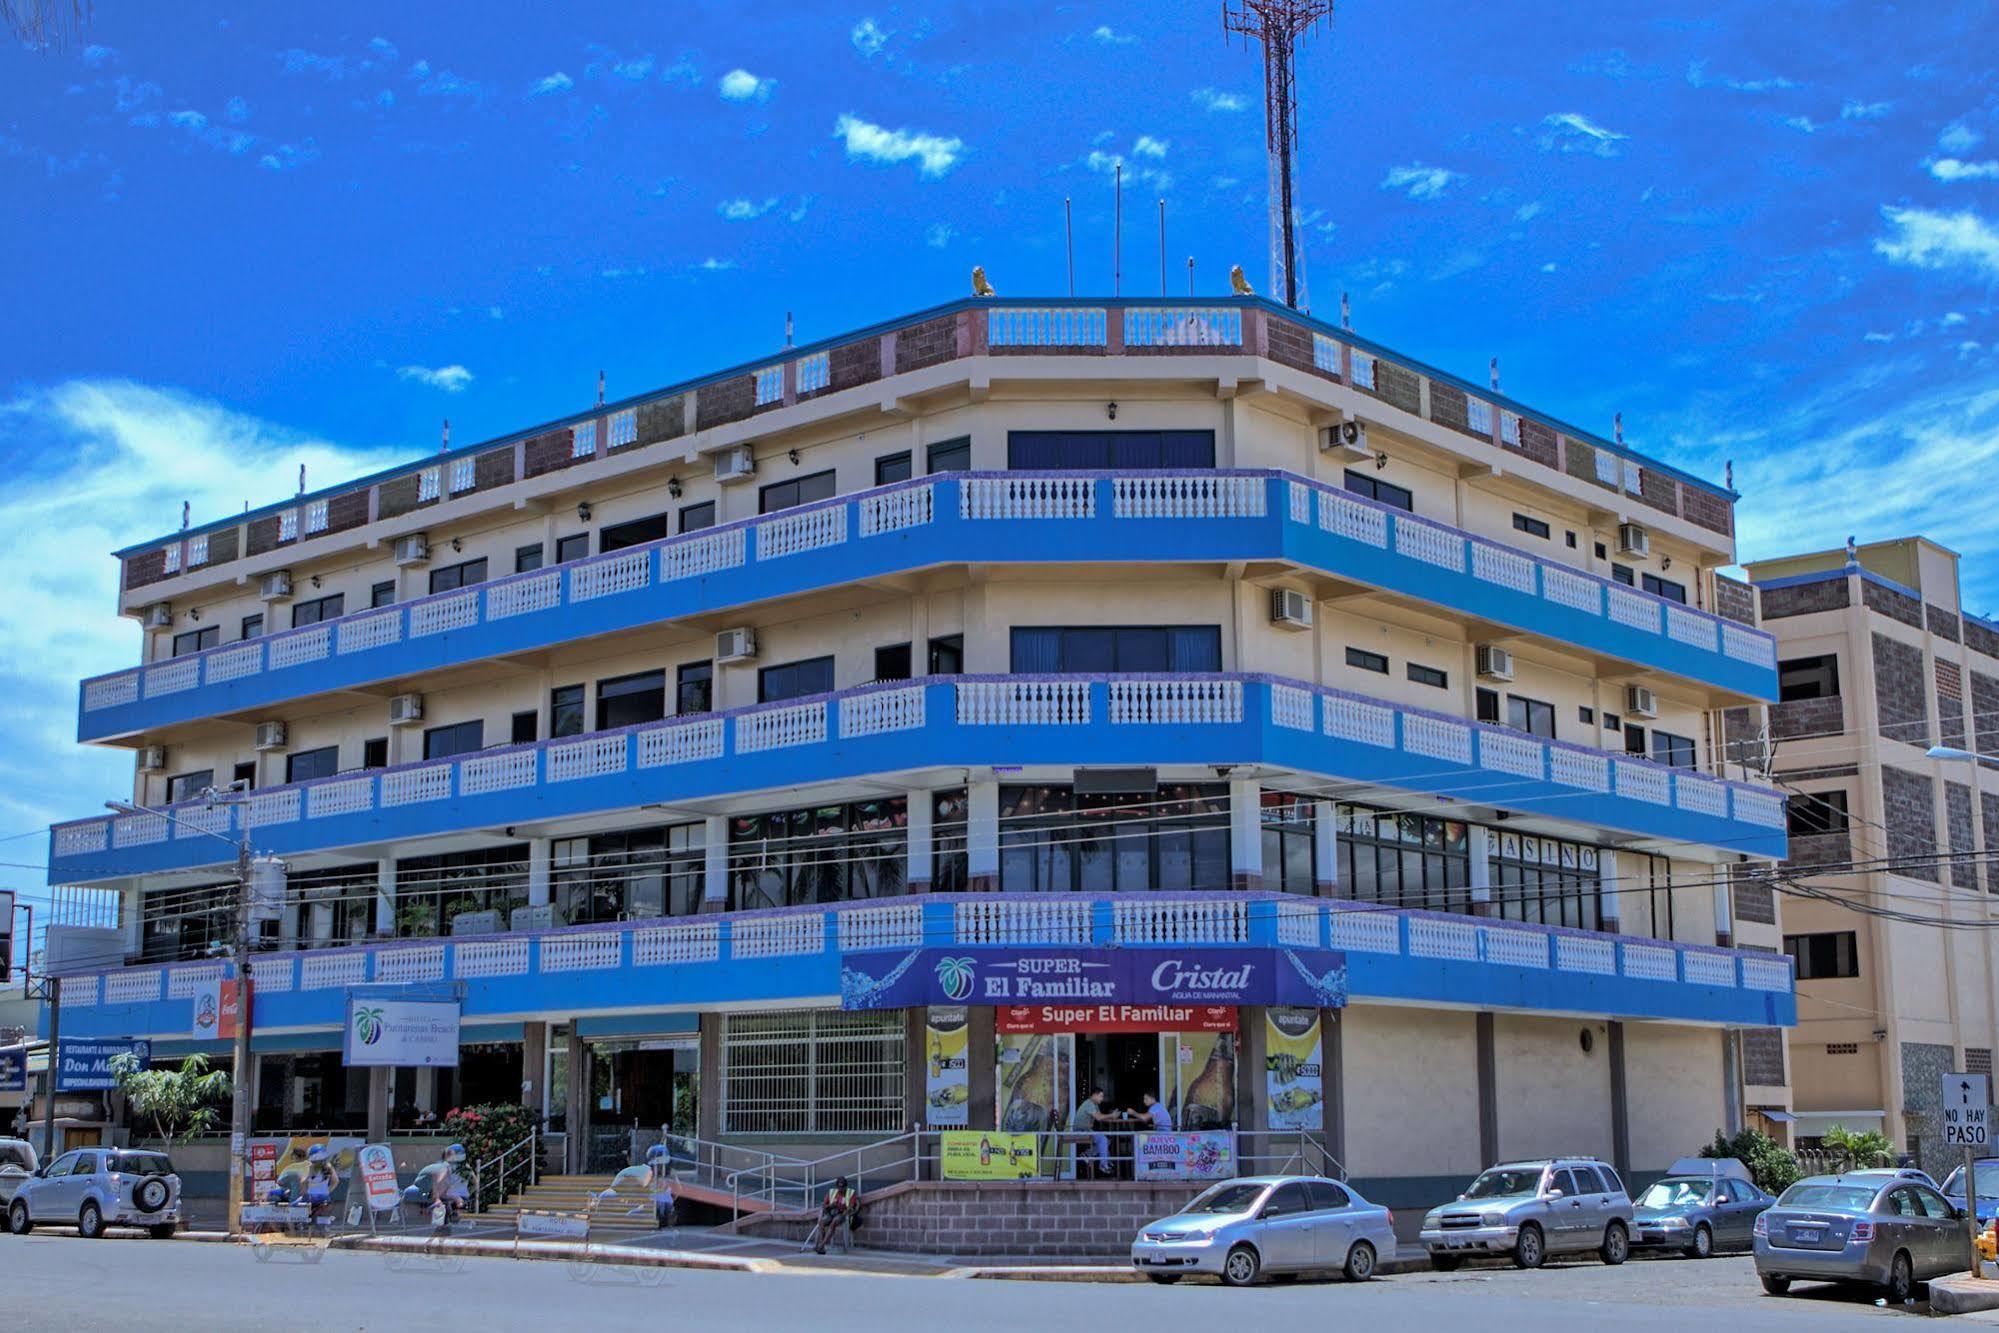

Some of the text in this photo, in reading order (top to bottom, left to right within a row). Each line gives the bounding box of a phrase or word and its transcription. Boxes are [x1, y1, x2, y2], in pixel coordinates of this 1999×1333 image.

[1017, 958, 1081, 974] SUPER
[1151, 960, 1252, 991] Cristal
[984, 977, 1116, 997] El Familiar
[1171, 991, 1192, 999] AGUA
[1042, 1005, 1193, 1025] Super El Familiar
[64, 1057, 89, 1072] Don
[1945, 1109, 1985, 1122] NO HAY
[1947, 1126, 1986, 1143] PASO
